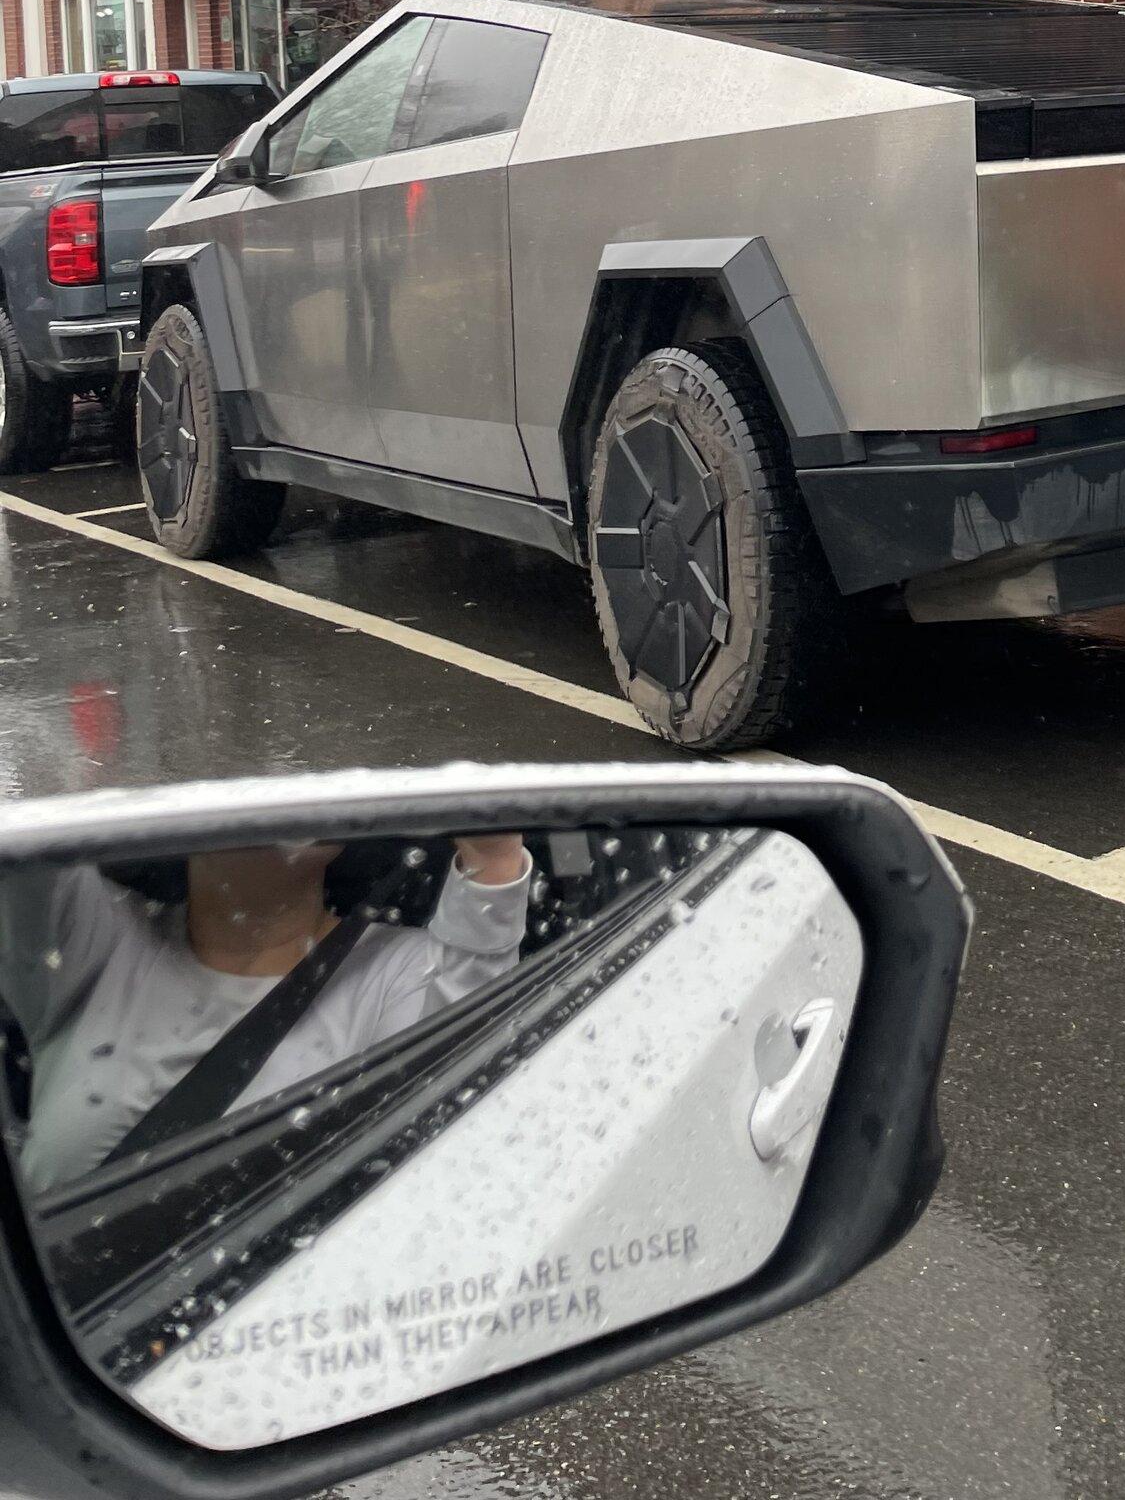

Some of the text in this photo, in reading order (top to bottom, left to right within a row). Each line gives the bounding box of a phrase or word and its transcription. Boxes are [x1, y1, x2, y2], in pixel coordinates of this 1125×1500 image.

[185, 1224, 700, 1363] OBJECTS IN MIRROR ARE CLOSER
[298, 1285, 601, 1380] THAN THEY APPEAR
